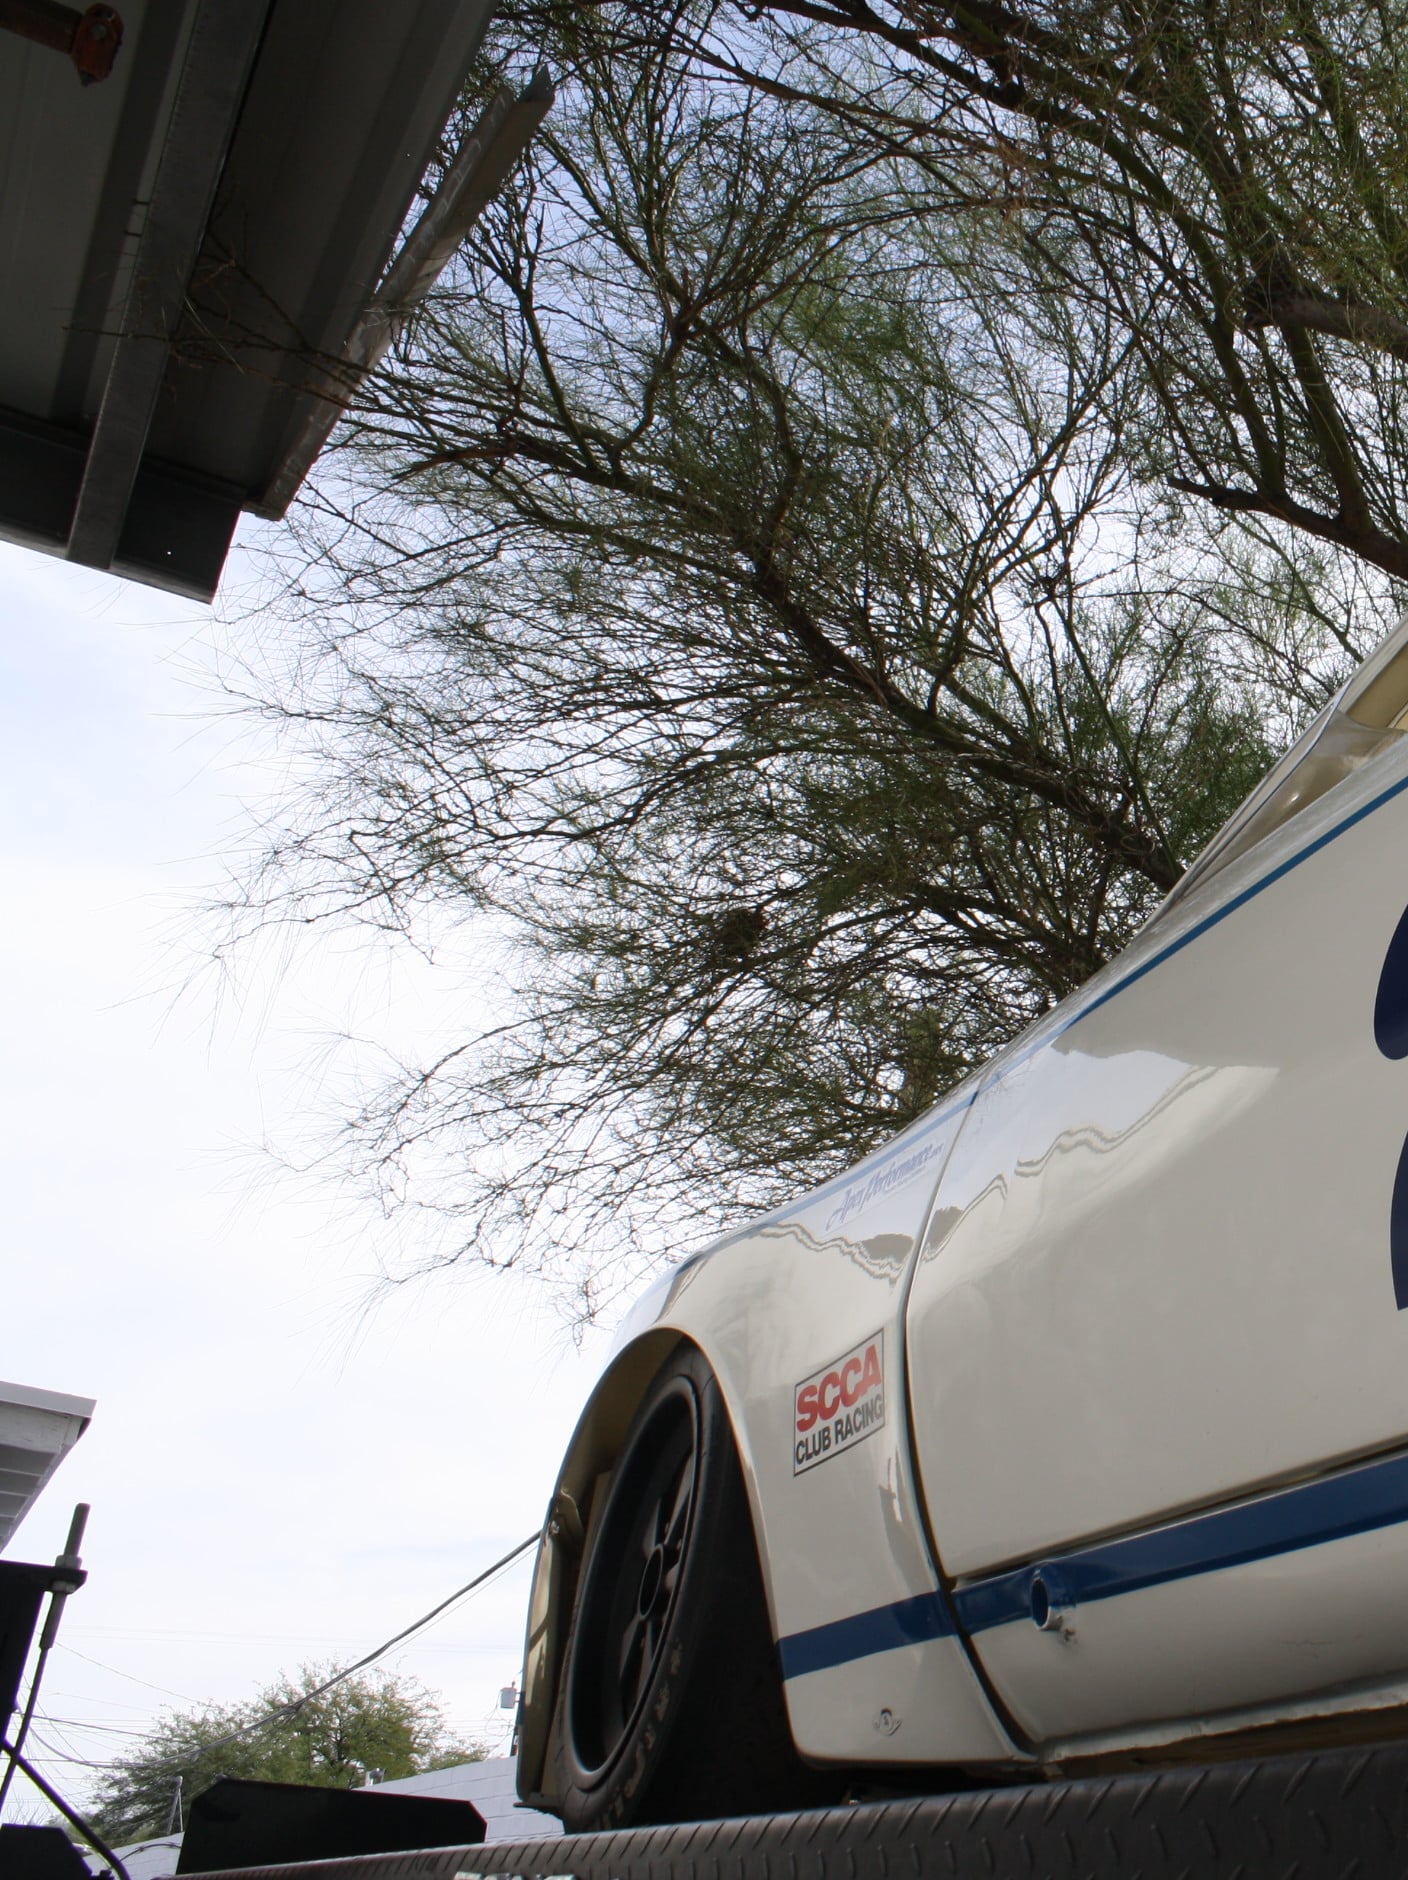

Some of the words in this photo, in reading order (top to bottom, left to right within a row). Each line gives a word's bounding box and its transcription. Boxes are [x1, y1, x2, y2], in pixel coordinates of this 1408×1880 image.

[796, 1344, 882, 1433] SCCA
[795, 1426, 832, 1465] CLUB
[834, 1394, 884, 1445] RACING
